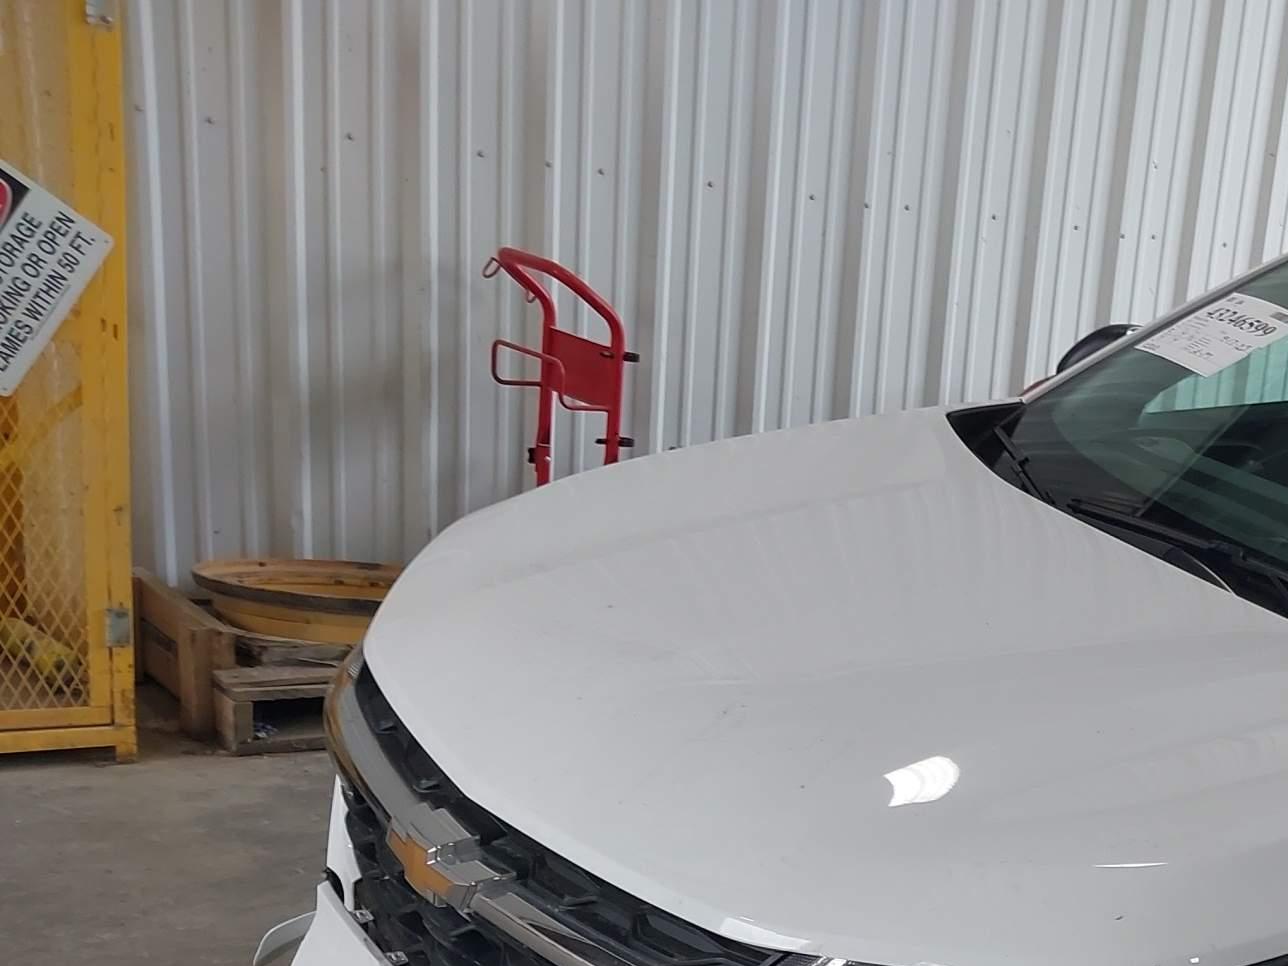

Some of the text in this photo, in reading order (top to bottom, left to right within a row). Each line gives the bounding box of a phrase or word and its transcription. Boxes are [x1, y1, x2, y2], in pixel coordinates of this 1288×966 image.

[20, 253, 48, 278] OR
[37, 211, 76, 256] OPEN
[22, 273, 69, 322] WITHIN
[57, 252, 80, 273] 50
[70, 231, 96, 256] FT.
